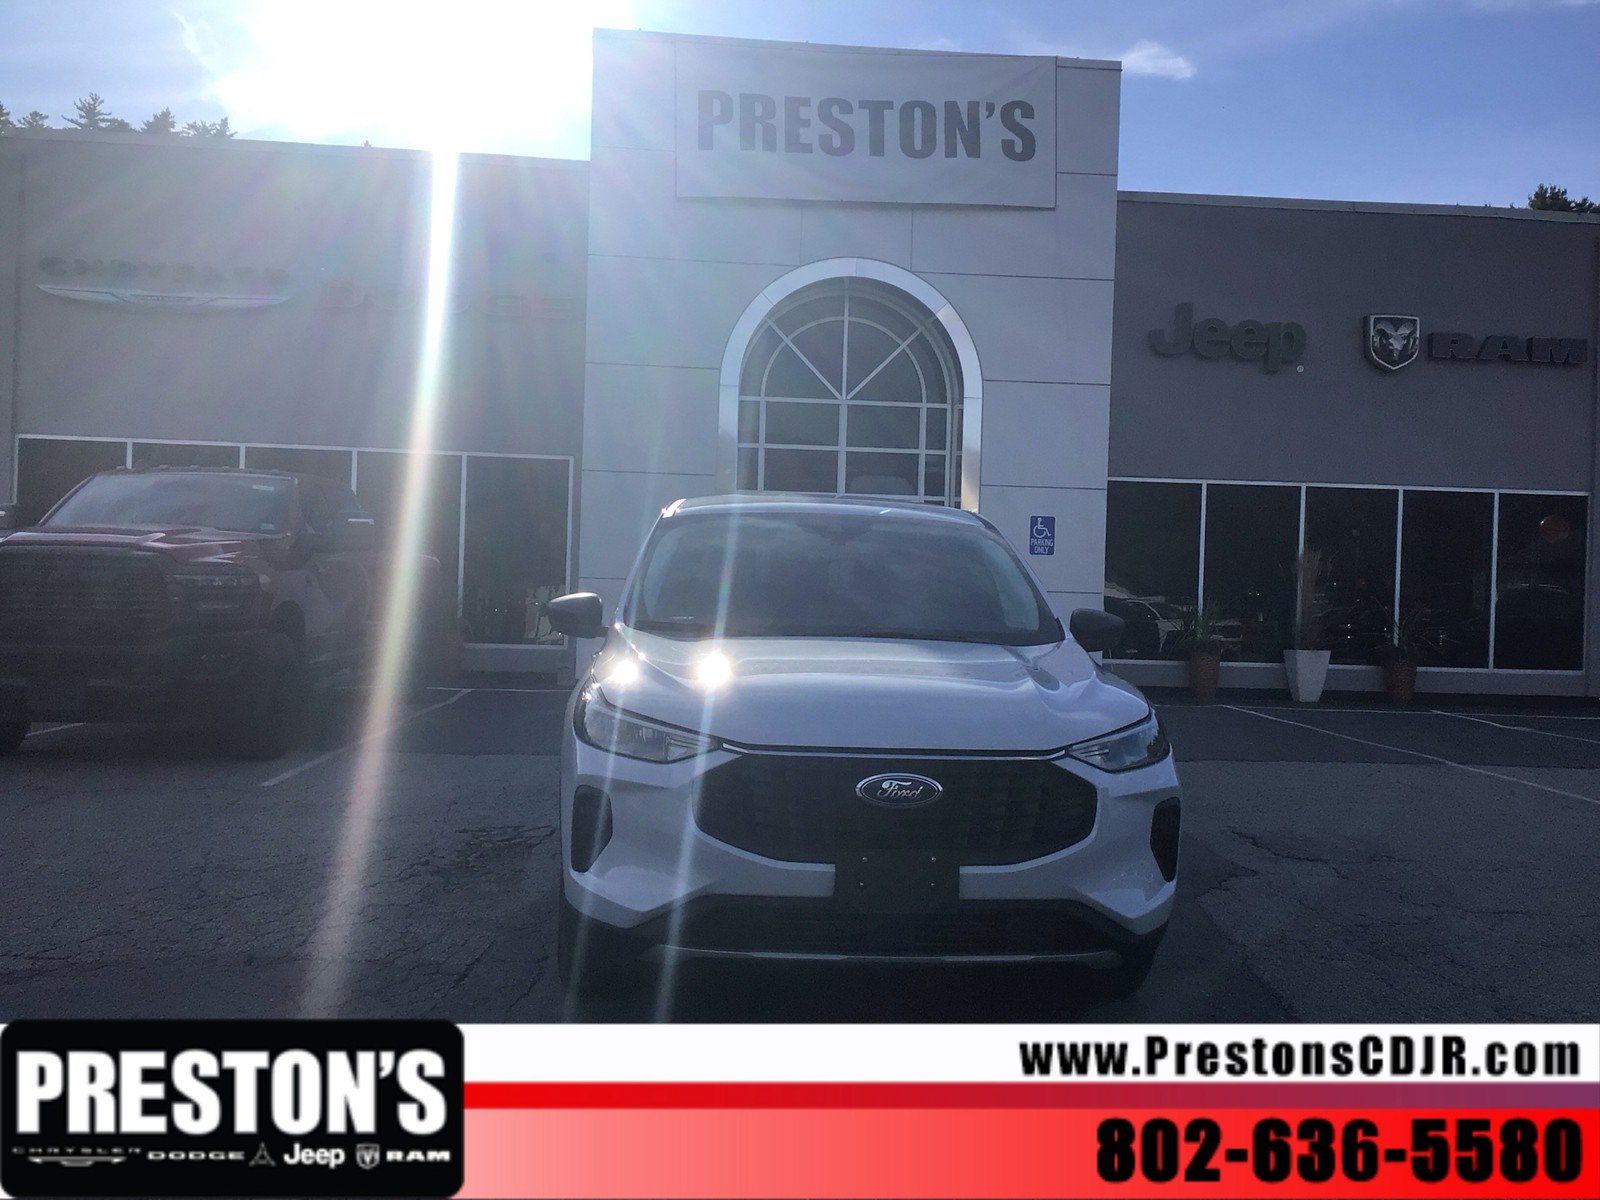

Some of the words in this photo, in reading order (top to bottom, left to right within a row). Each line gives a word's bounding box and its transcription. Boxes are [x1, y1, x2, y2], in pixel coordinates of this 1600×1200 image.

[697, 89, 1036, 162] PRESTON'S
[1149, 302, 1306, 374] Jeep
[1428, 332, 1588, 365] RAM
[1030, 538, 1054, 547] PARKING
[1034, 546, 1050, 554] ONLY
[877, 780, 923, 798] Ford
